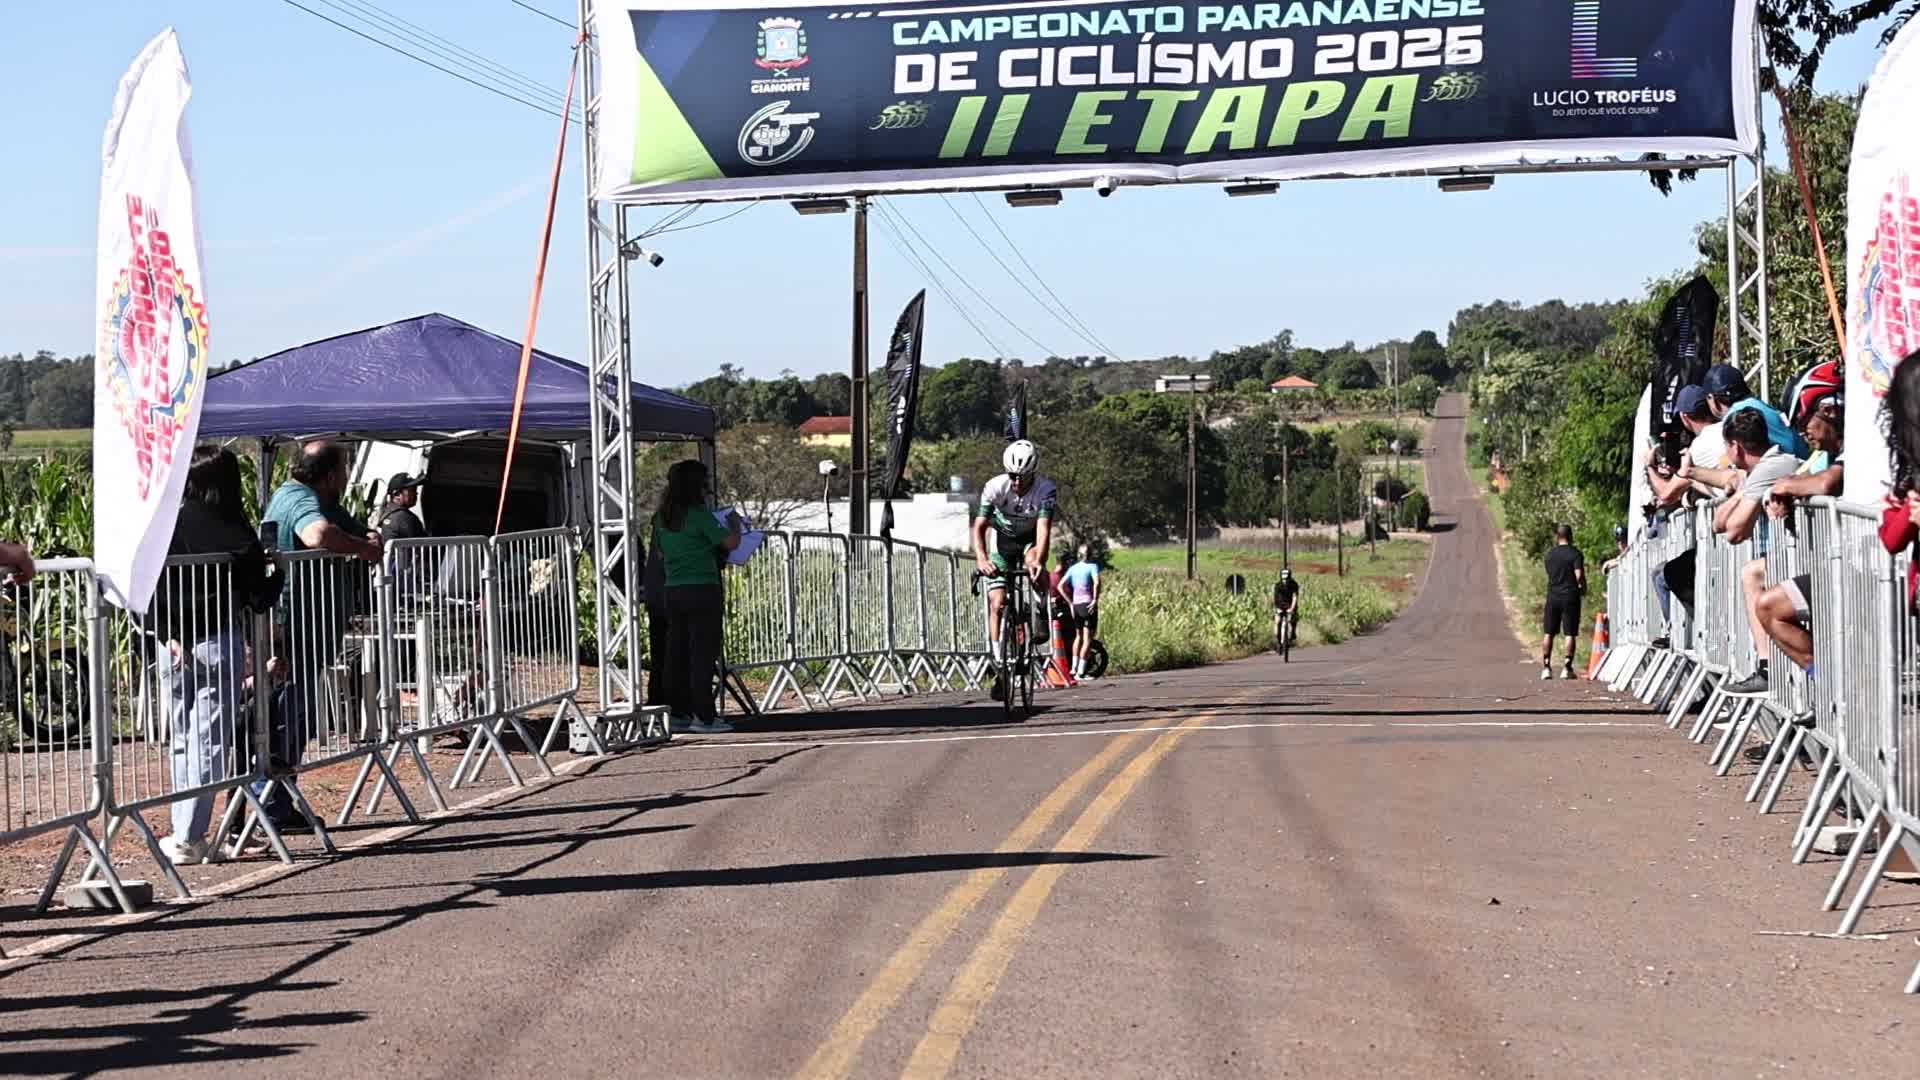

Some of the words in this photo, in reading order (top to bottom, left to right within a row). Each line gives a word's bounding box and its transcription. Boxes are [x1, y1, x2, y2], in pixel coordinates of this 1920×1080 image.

[893, 6, 1184, 46] CAMPEONATO
[1198, 0, 1485, 32] PARANAENSE
[894, 51, 978, 94] DE
[998, 32, 1294, 88] CICLÍSMO
[751, 82, 810, 94] CIANORTE
[1533, 90, 1590, 106] LUCIO
[1594, 86, 1677, 103] TROFÉUS
[938, 94, 1031, 158] II
[1055, 74, 1420, 154] ETAPA
[1552, 109, 1565, 117] DO
[1566, 108, 1587, 117] JEITO
[1588, 107, 1605, 116] QUE
